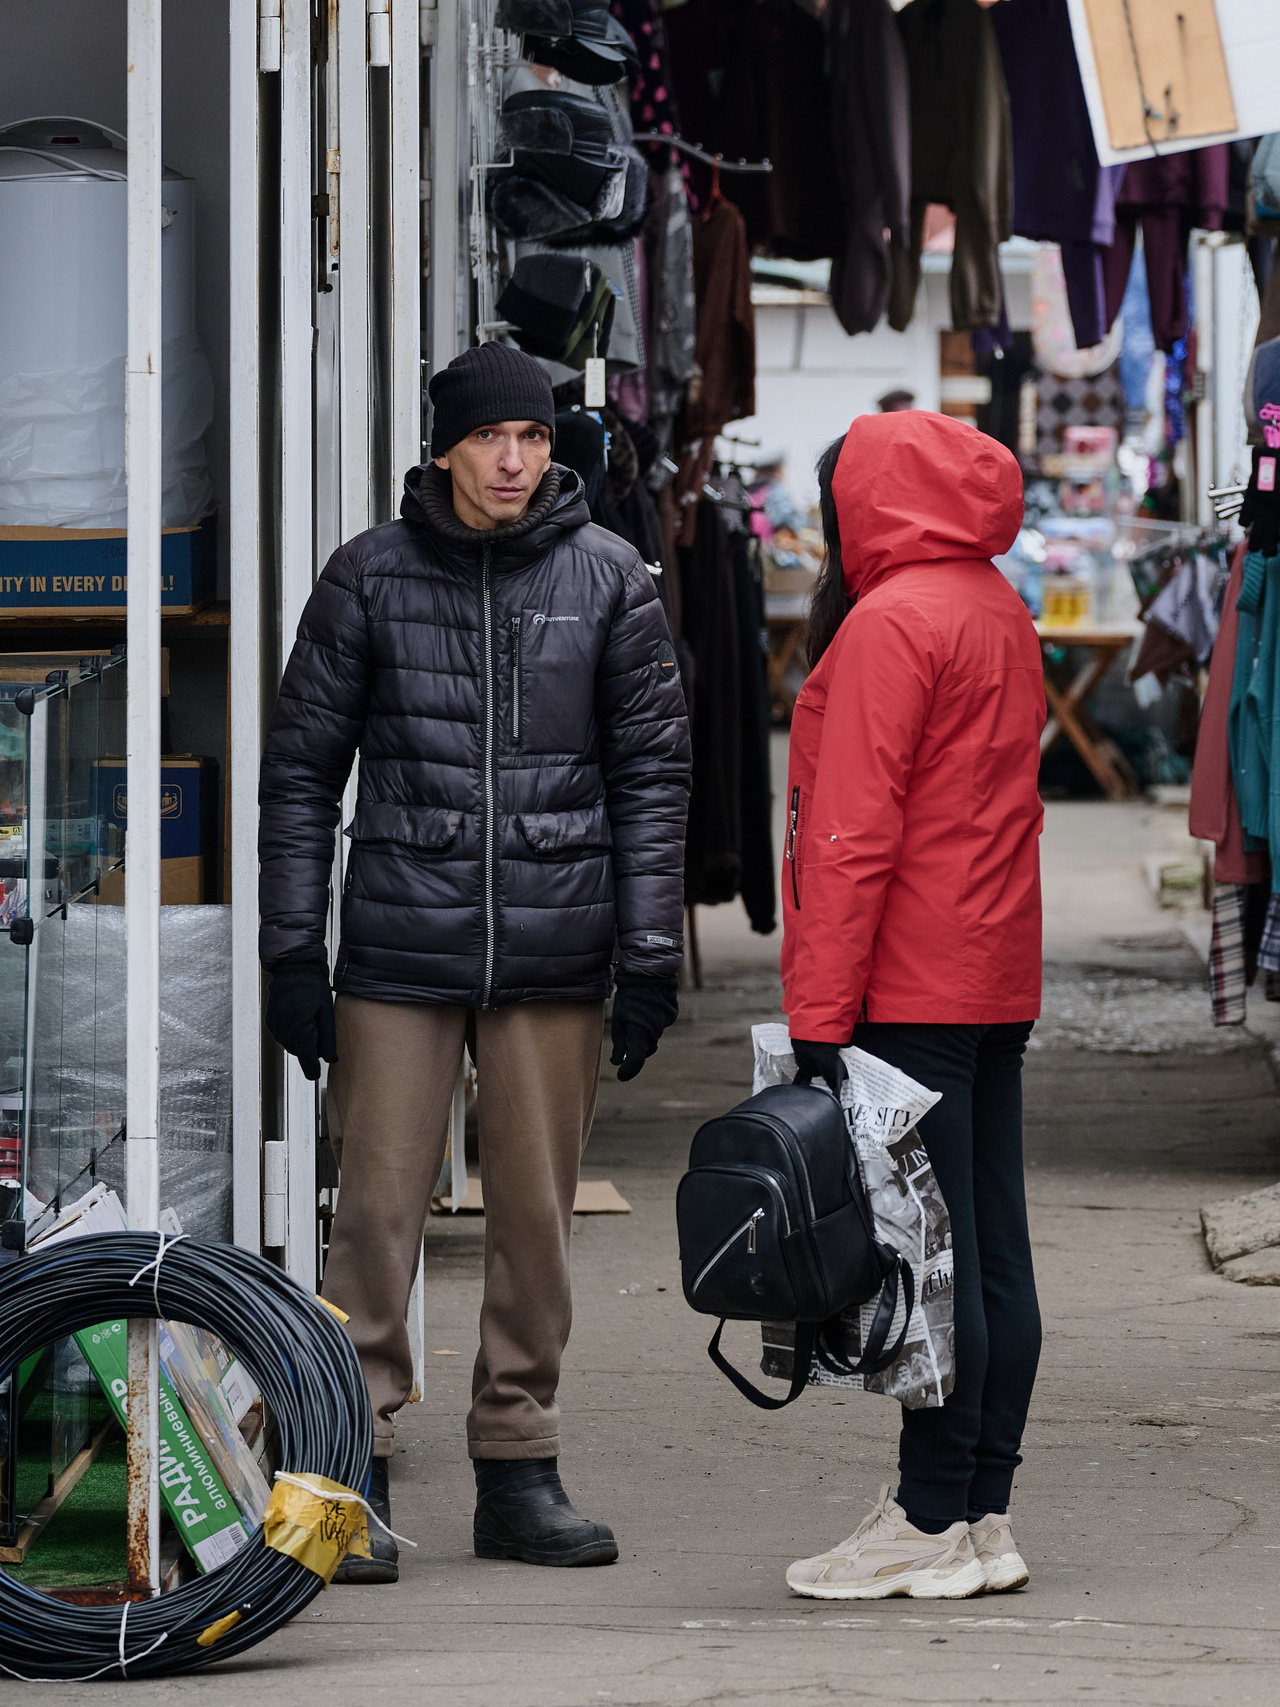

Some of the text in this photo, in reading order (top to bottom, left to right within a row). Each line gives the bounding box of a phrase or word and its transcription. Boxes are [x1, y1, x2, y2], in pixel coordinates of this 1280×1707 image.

[30, 576, 47, 593] IN
[52, 576, 106, 592] EVERY
[875, 1106, 920, 1128] SITY
